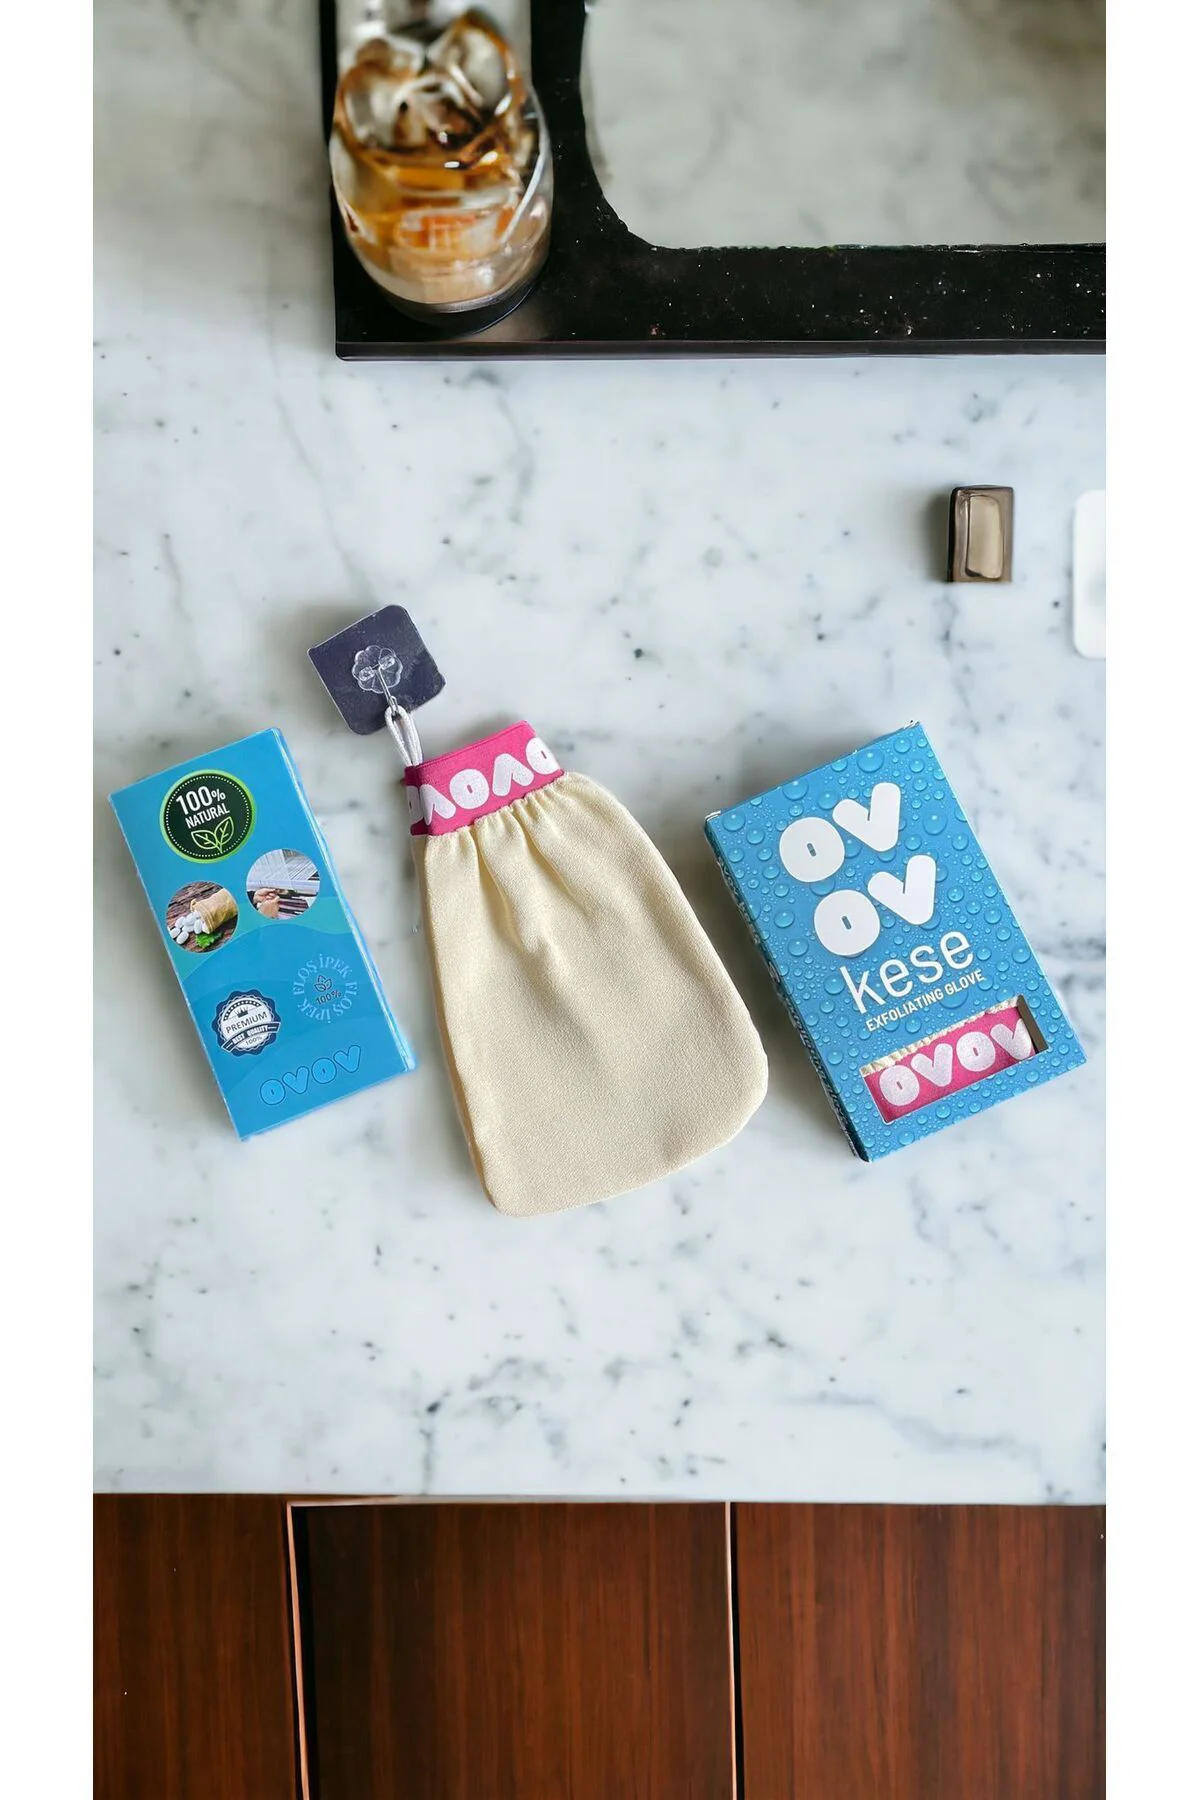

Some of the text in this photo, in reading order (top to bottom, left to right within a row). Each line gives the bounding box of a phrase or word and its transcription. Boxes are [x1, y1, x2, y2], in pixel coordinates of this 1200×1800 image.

[175, 785, 226, 815] 100%
[185, 802, 230, 829] NATURAL
[778, 782, 901, 883] OV
[813, 854, 937, 957] OV
[315, 990, 341, 1005] 100%
[839, 930, 974, 1015] kese
[865, 969, 985, 1032] EXFOLIATING GLOVE
[225, 1011, 268, 1034] PREMIUM
[259, 1044, 362, 1106] OVOV
[879, 1017, 1035, 1107] OVOV
